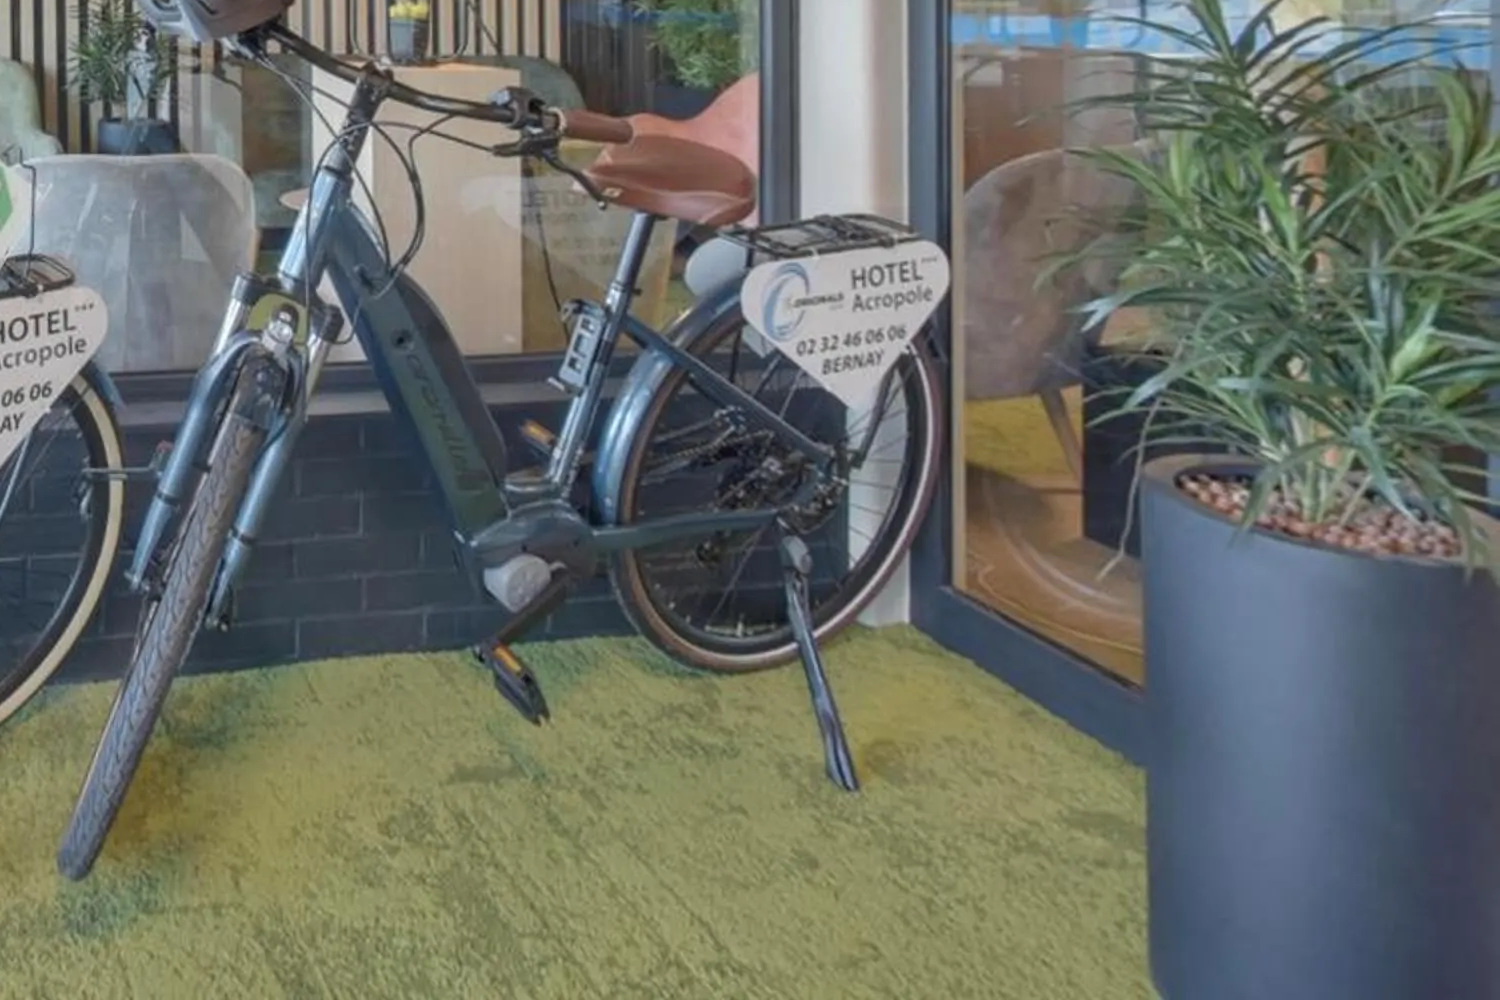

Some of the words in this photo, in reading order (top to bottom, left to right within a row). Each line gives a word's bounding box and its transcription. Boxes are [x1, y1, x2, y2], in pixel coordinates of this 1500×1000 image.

[851, 261, 923, 290] HOTEL
[852, 285, 933, 312] Acropole
[796, 338, 817, 357] 02
[820, 334, 839, 353] 32
[843, 330, 862, 347] 46
[865, 327, 885, 344] 06
[887, 324, 906, 342] 06
[822, 348, 885, 375] BERNAY
[2, 386, 25, 408] 06
[30, 381, 52, 401] 06
